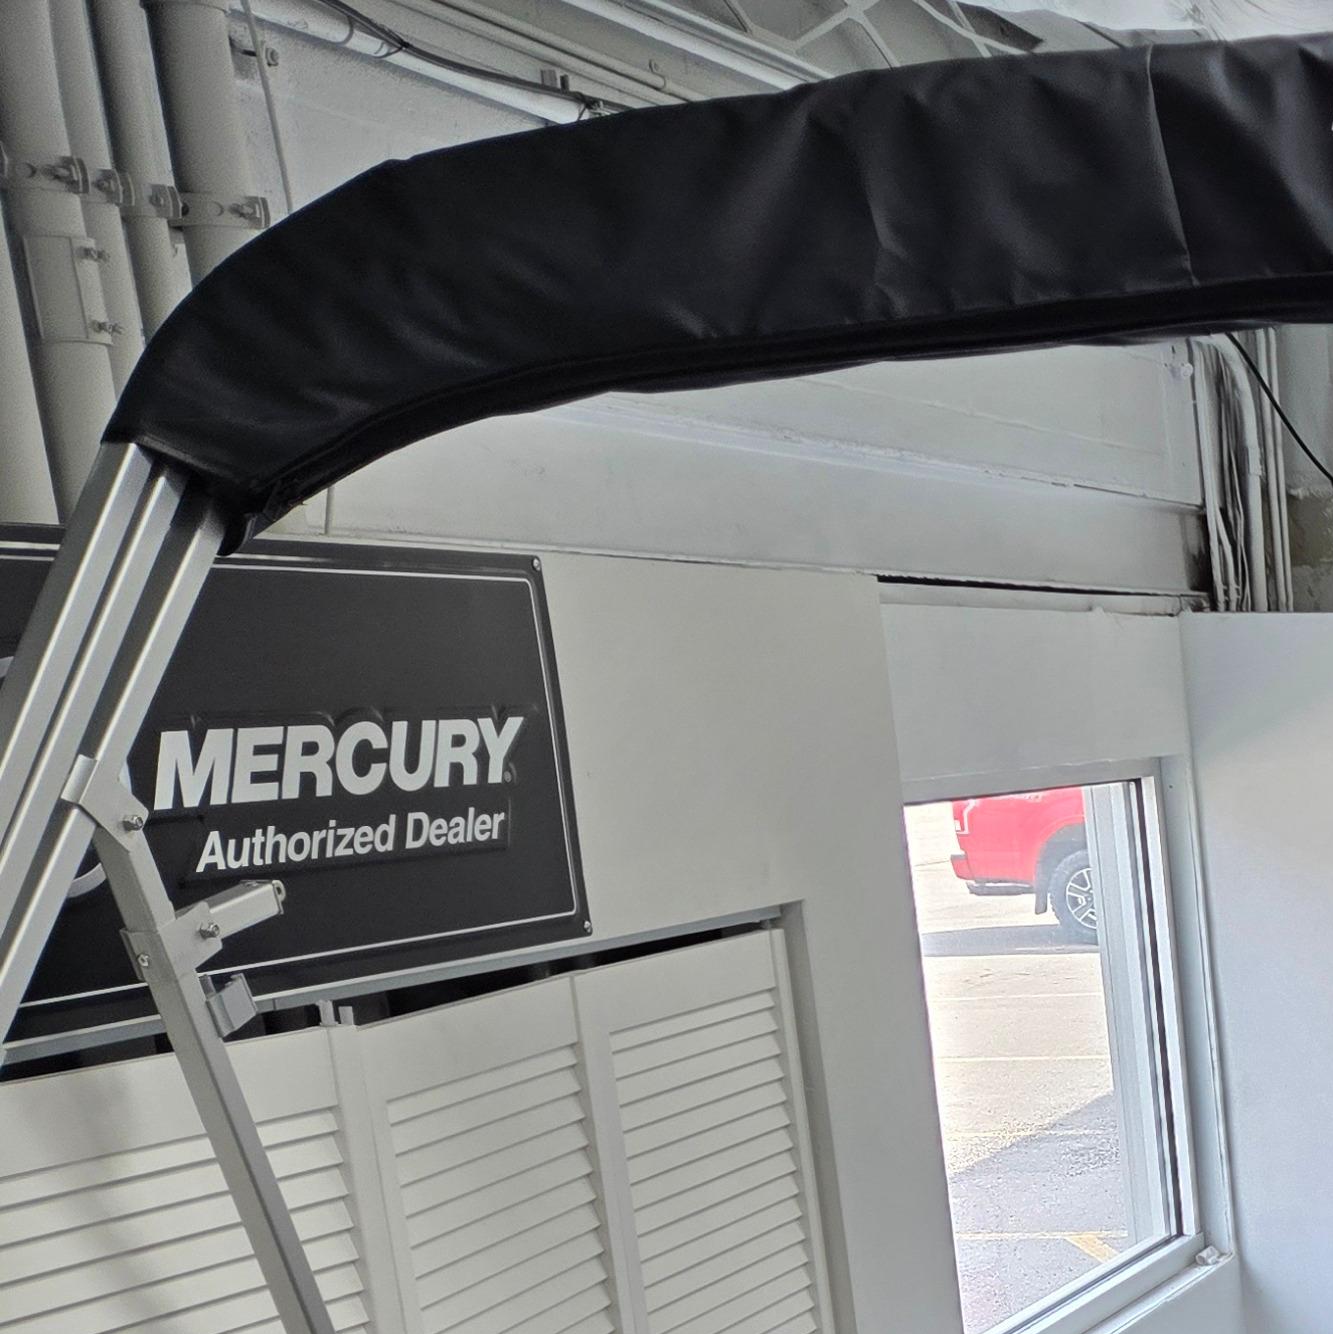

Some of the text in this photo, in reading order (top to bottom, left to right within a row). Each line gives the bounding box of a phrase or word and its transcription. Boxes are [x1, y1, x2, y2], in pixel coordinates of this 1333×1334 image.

[153, 715, 525, 811] MERCURY
[195, 807, 505, 873] Authorized Dealer
